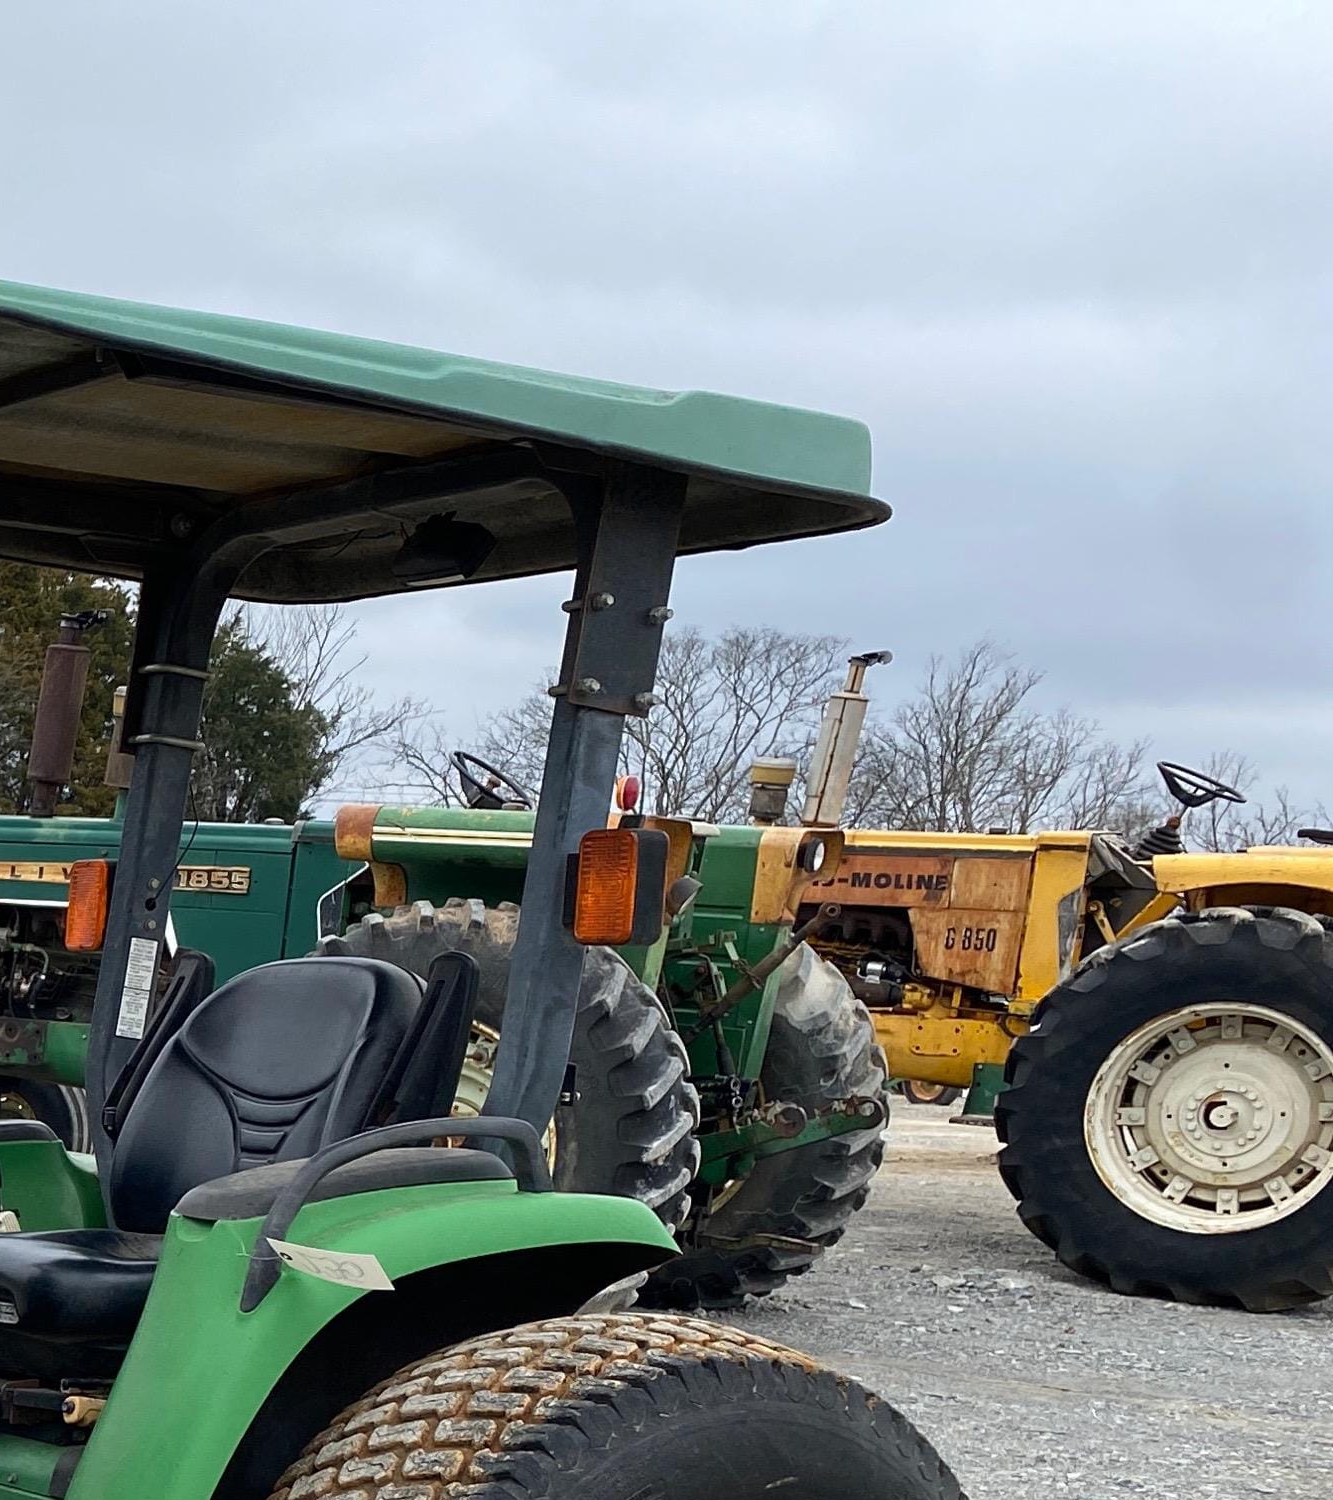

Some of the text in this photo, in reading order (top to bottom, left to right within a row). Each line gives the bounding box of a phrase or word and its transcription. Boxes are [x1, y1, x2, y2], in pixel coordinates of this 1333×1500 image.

[177, 869, 250, 891] 1855
[944, 927, 997, 952] G 850
